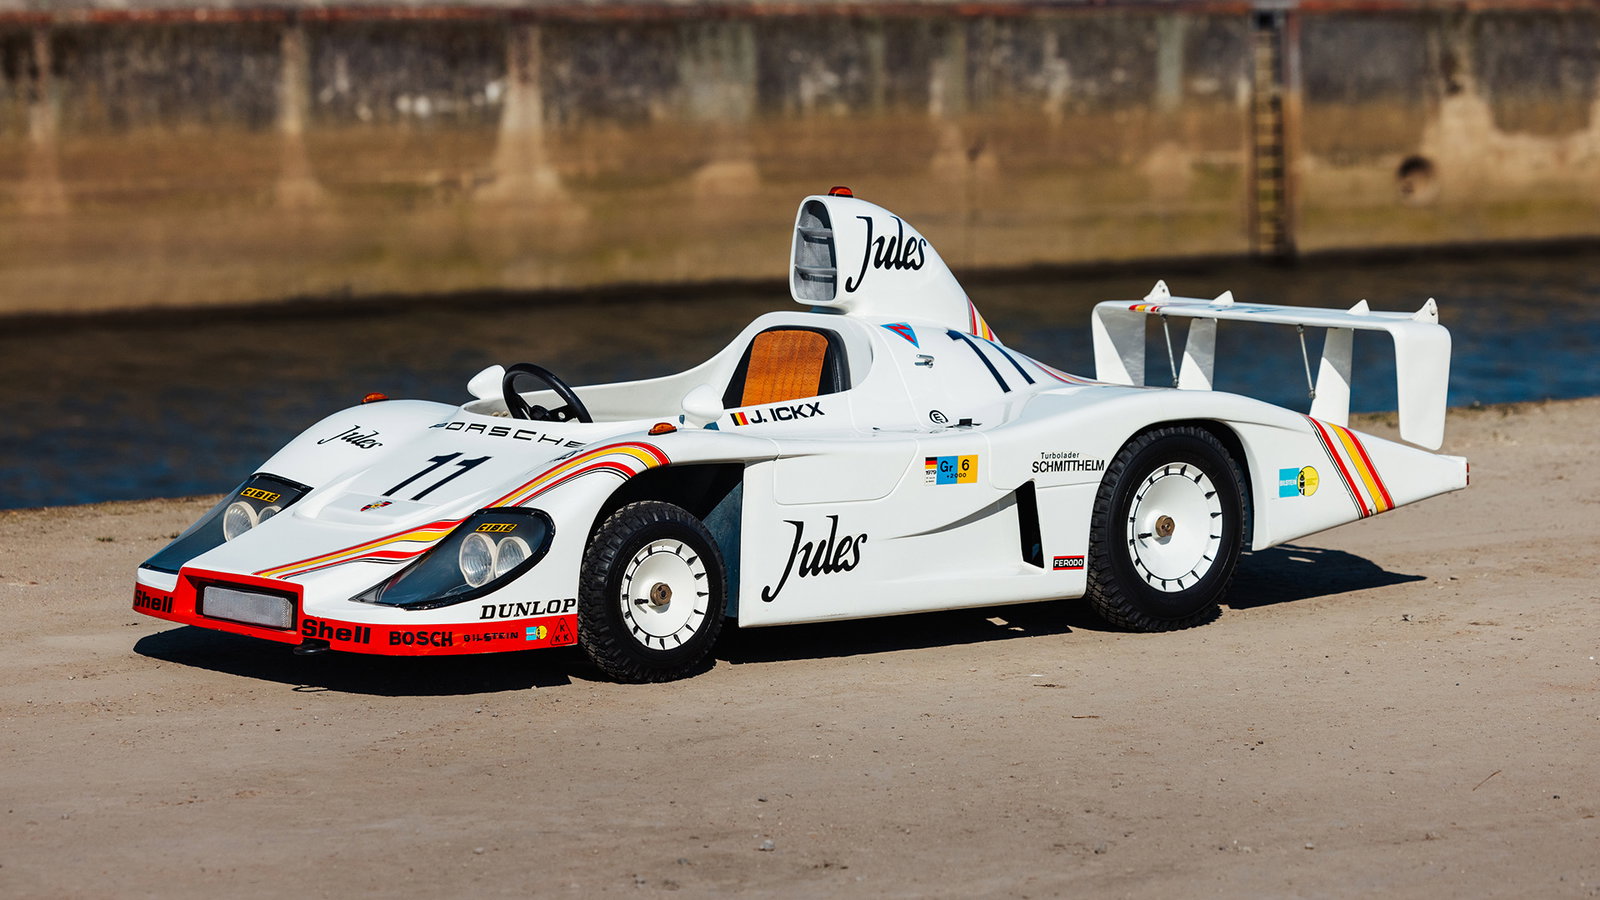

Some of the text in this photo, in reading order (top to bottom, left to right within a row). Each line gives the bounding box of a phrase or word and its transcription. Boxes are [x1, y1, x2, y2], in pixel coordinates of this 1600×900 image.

[845, 215, 927, 293] Jules
[945, 328, 1036, 394] 11
[750, 401, 826, 424] J. ICKX
[317, 424, 384, 450] Jules
[428, 421, 587, 449] PORSCHE
[940, 458, 970, 473] Gr 6
[1031, 459, 1105, 474] SCHMITTHELM
[1040, 451, 1080, 460] Turbolader
[381, 452, 494, 501] 11
[760, 514, 868, 603] Jules
[1054, 558, 1083, 567] FERODO
[133, 589, 174, 614] Shell
[479, 598, 577, 620] DUNLOP
[301, 618, 372, 645] Shell
[389, 631, 454, 647] BOSCH
[463, 631, 519, 643] BILSTEIN
